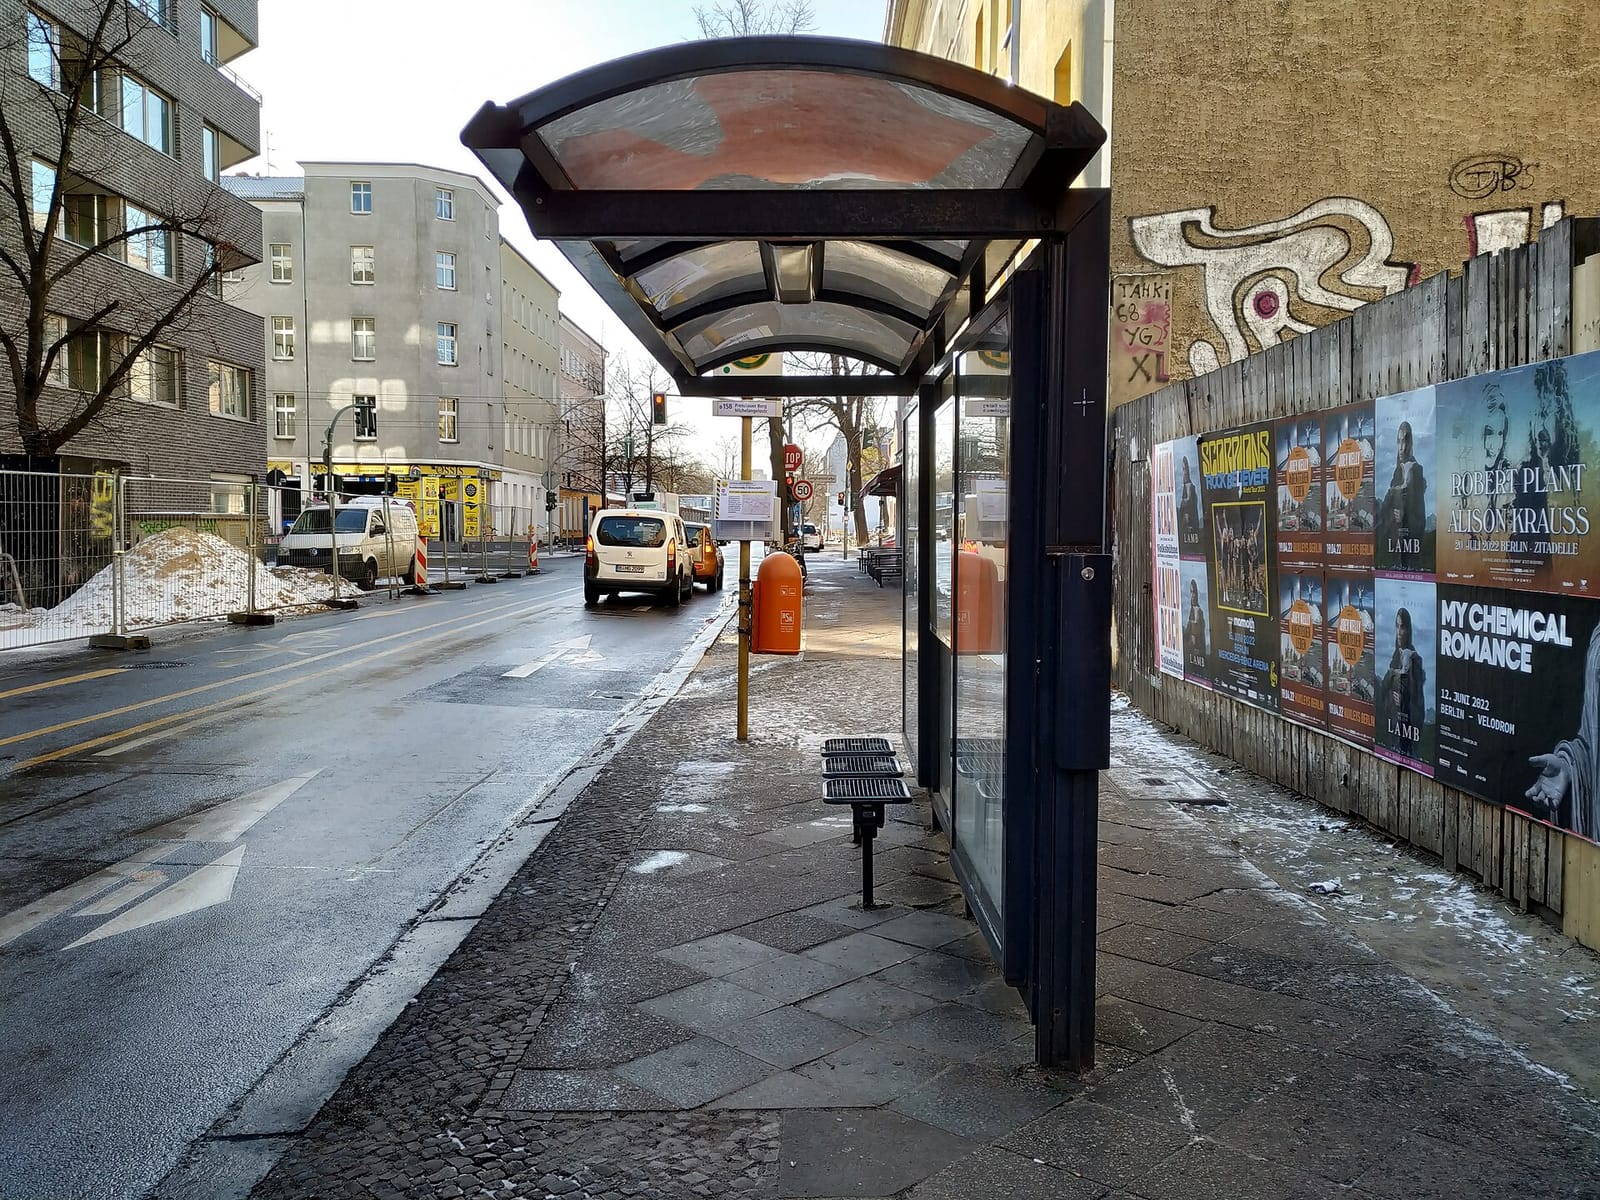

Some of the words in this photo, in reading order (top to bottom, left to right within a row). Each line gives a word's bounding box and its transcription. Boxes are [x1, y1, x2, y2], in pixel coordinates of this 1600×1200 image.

[785, 452, 800, 464] TOP
[1202, 431, 1270, 476] SCORPIONS
[797, 485, 809, 495] 50
[1452, 468, 1518, 497] ROBERT
[1523, 463, 1587, 493] PLANT
[1448, 508, 1507, 534] ALISON
[1512, 506, 1590, 535] KRAUSS
[1184, 533, 1198, 544] LAMB
[1388, 538, 1420, 553] LAMB
[1482, 541, 1500, 552] 2022
[1500, 540, 1528, 553] BERLIN
[1534, 542, 1579, 555] ZITADELLE
[1442, 600, 1468, 628] MY
[1469, 603, 1573, 647] CHEMICAL
[1190, 654, 1205, 668] LAMB
[1441, 629, 1533, 674] ROMANCE
[1440, 688, 1452, 701] 12.
[1453, 691, 1471, 706] JUNI
[1472, 696, 1490, 712] 2022
[1388, 718, 1420, 742] LAMB
[1440, 703, 1464, 720] BERLIN
[1478, 714, 1516, 736] VELODROM
